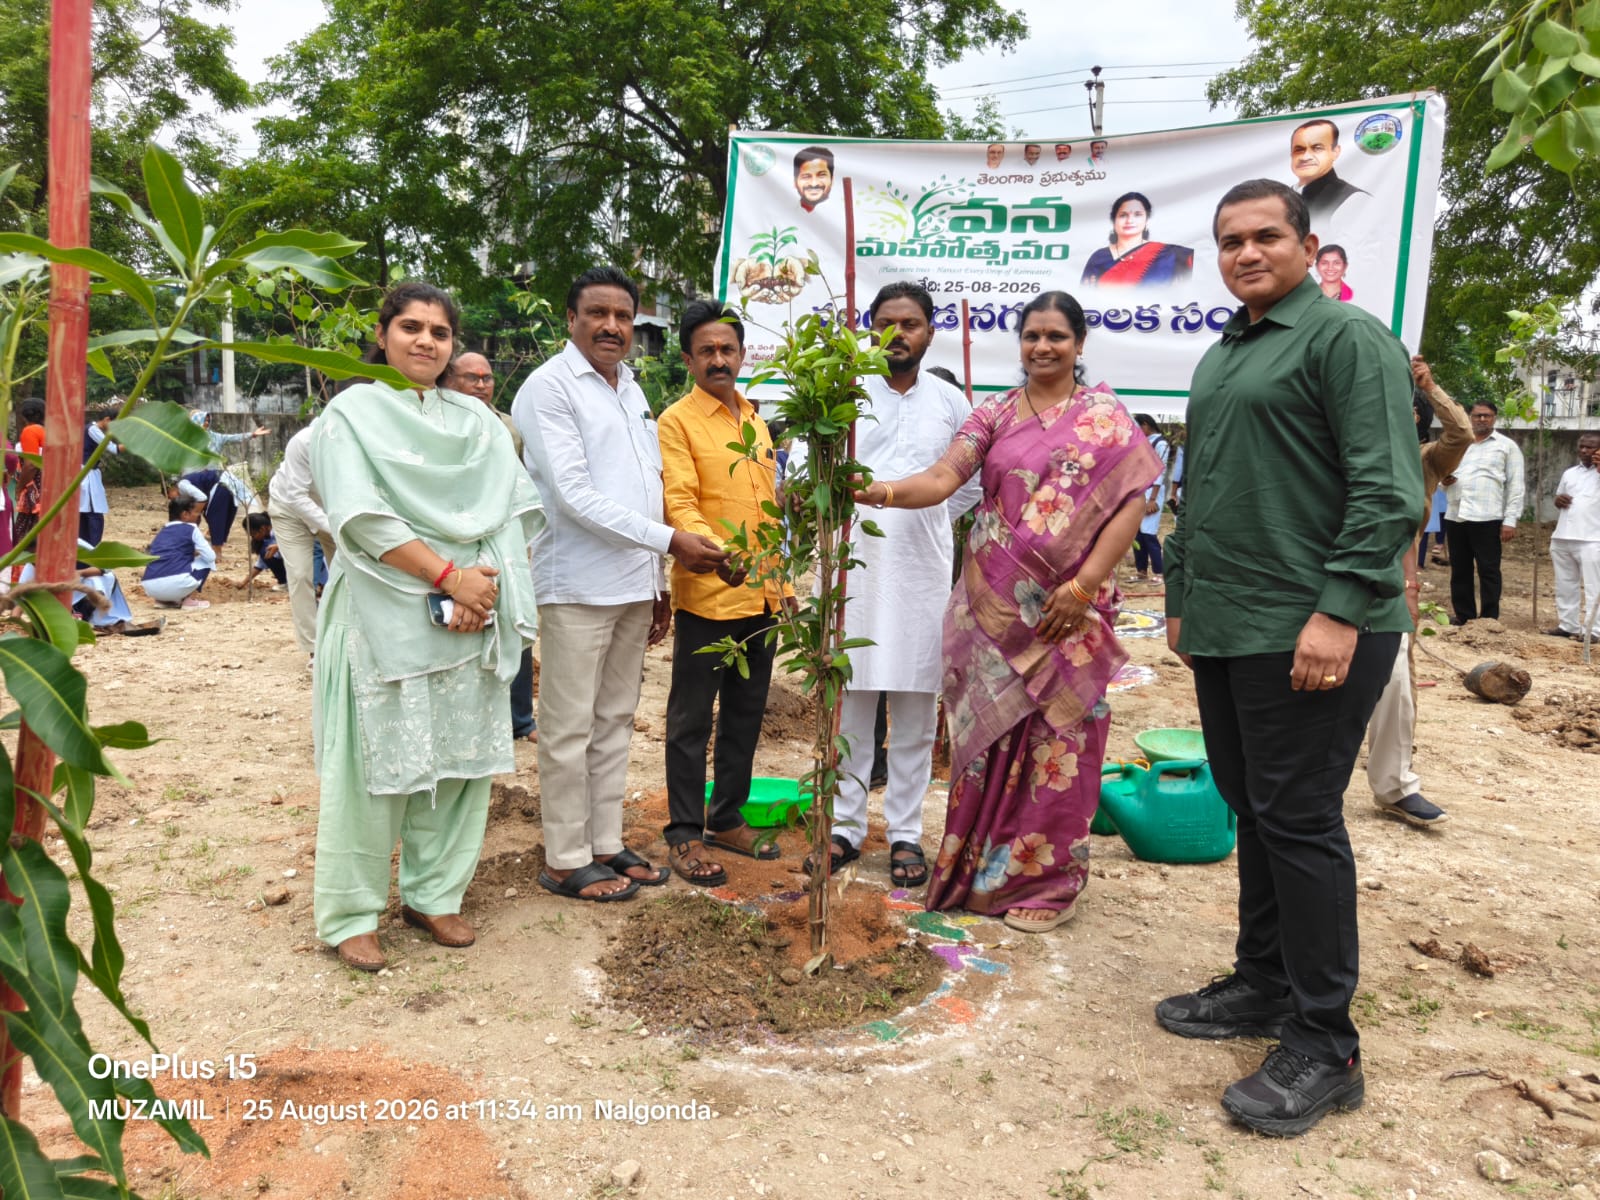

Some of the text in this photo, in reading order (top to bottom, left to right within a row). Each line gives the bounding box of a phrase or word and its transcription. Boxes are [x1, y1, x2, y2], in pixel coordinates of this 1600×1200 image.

[977, 169, 1107, 187] తెలంగాణ ప్రభుత్వము
[944, 281, 1041, 293] 25-08-2026
